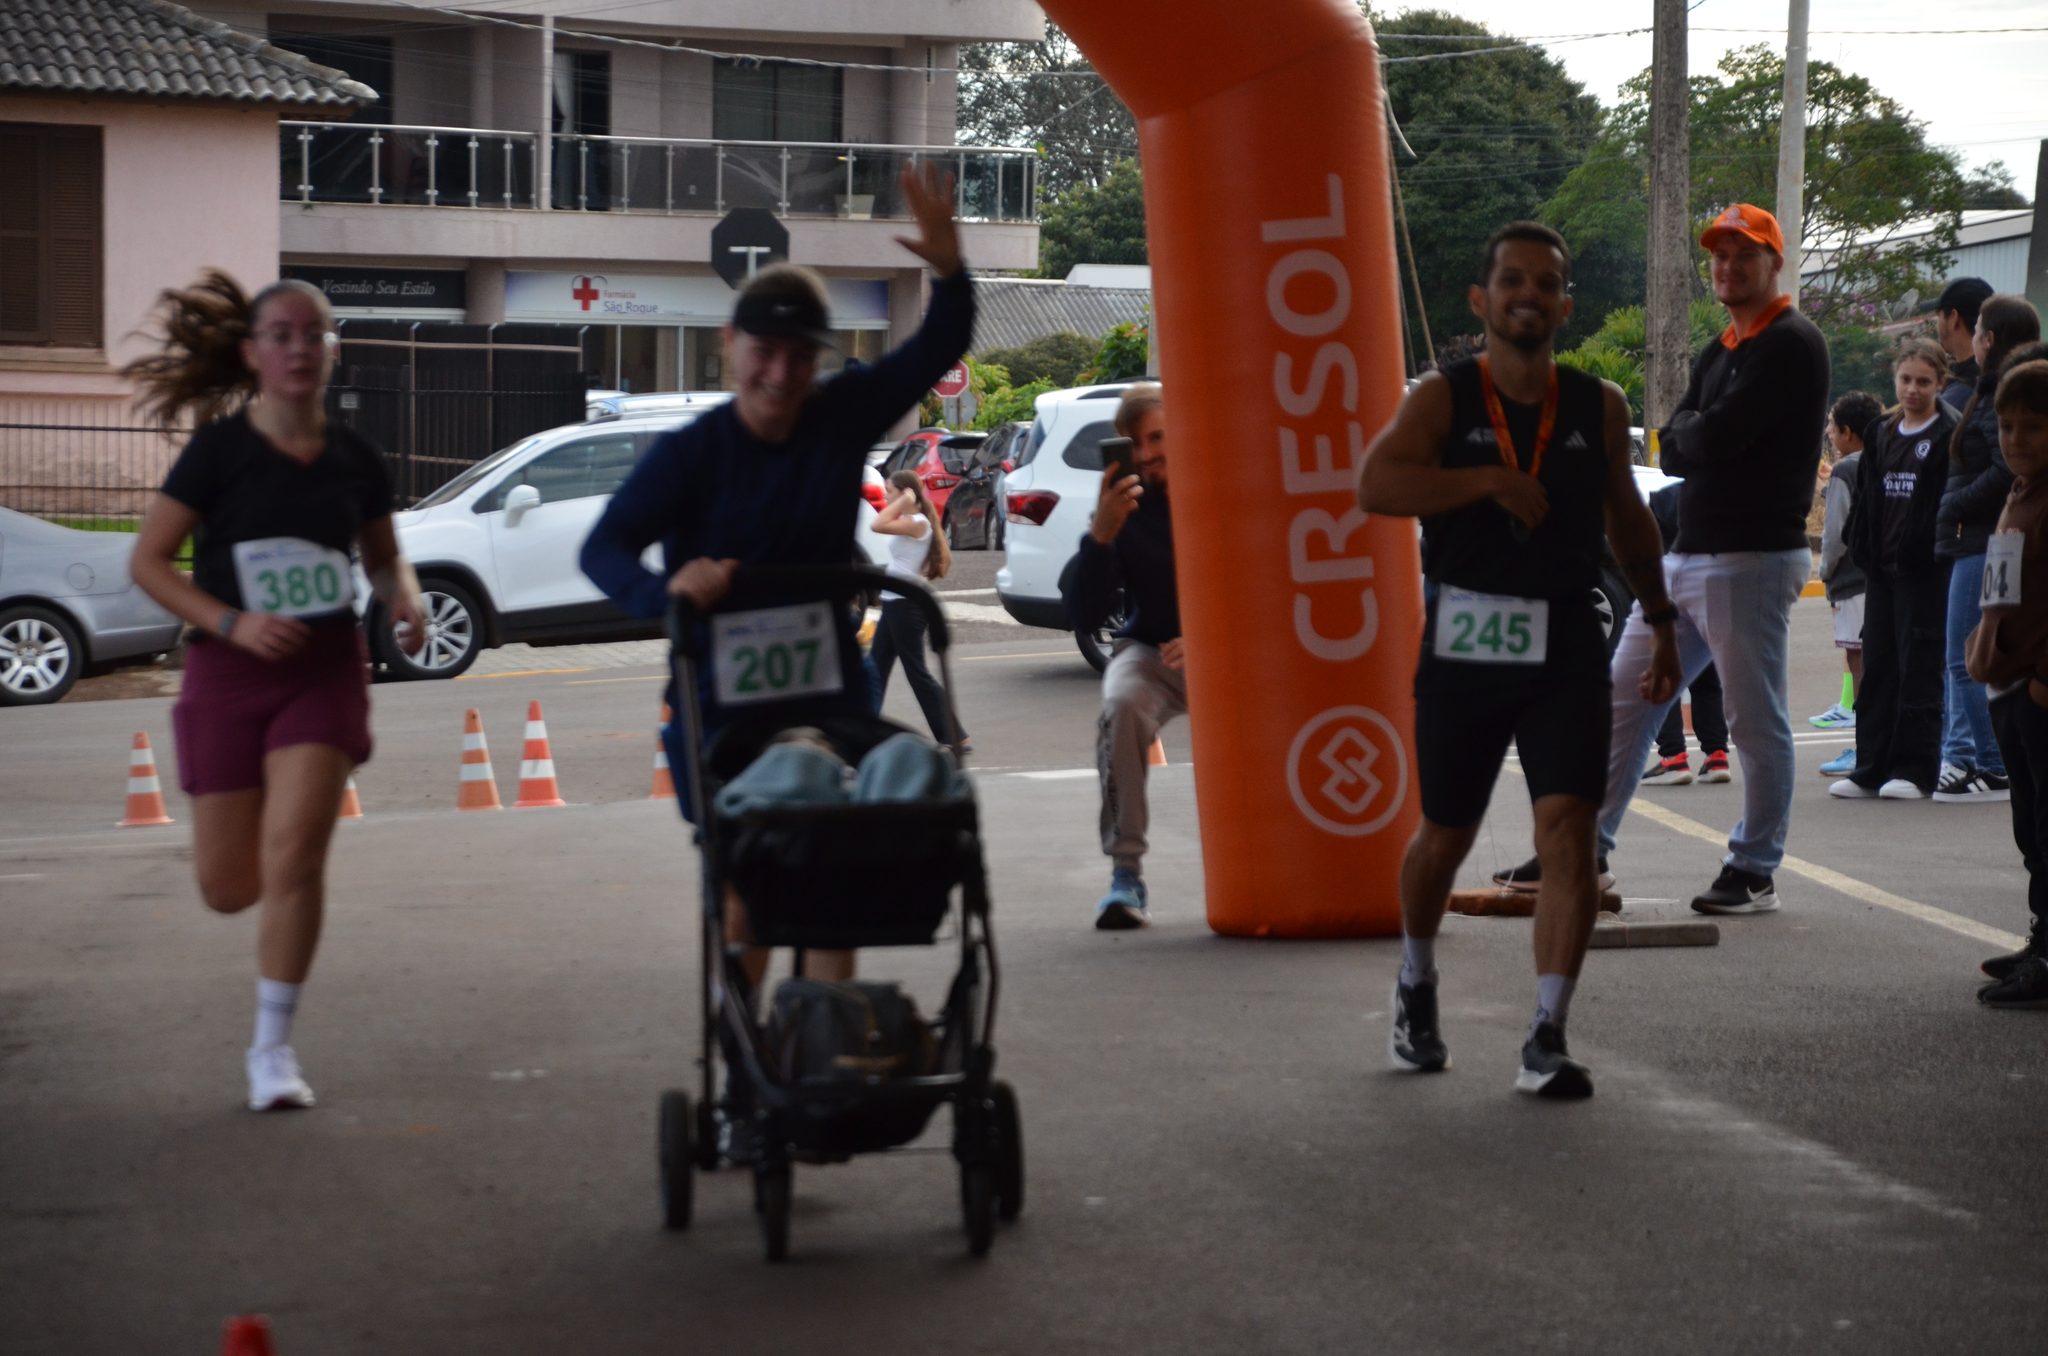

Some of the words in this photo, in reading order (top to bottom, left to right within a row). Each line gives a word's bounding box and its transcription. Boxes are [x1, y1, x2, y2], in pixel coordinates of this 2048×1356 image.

[321, 279, 373, 294] Vestindo
[376, 280, 398, 295] Seu
[400, 281, 435, 296] Estilo
[604, 300, 623, 313] São
[940, 369, 963, 383] ARE
[1261, 173, 1379, 662] CRESOL
[256, 562, 340, 612] 380
[1449, 610, 1532, 656] 245
[733, 640, 819, 693] 207
